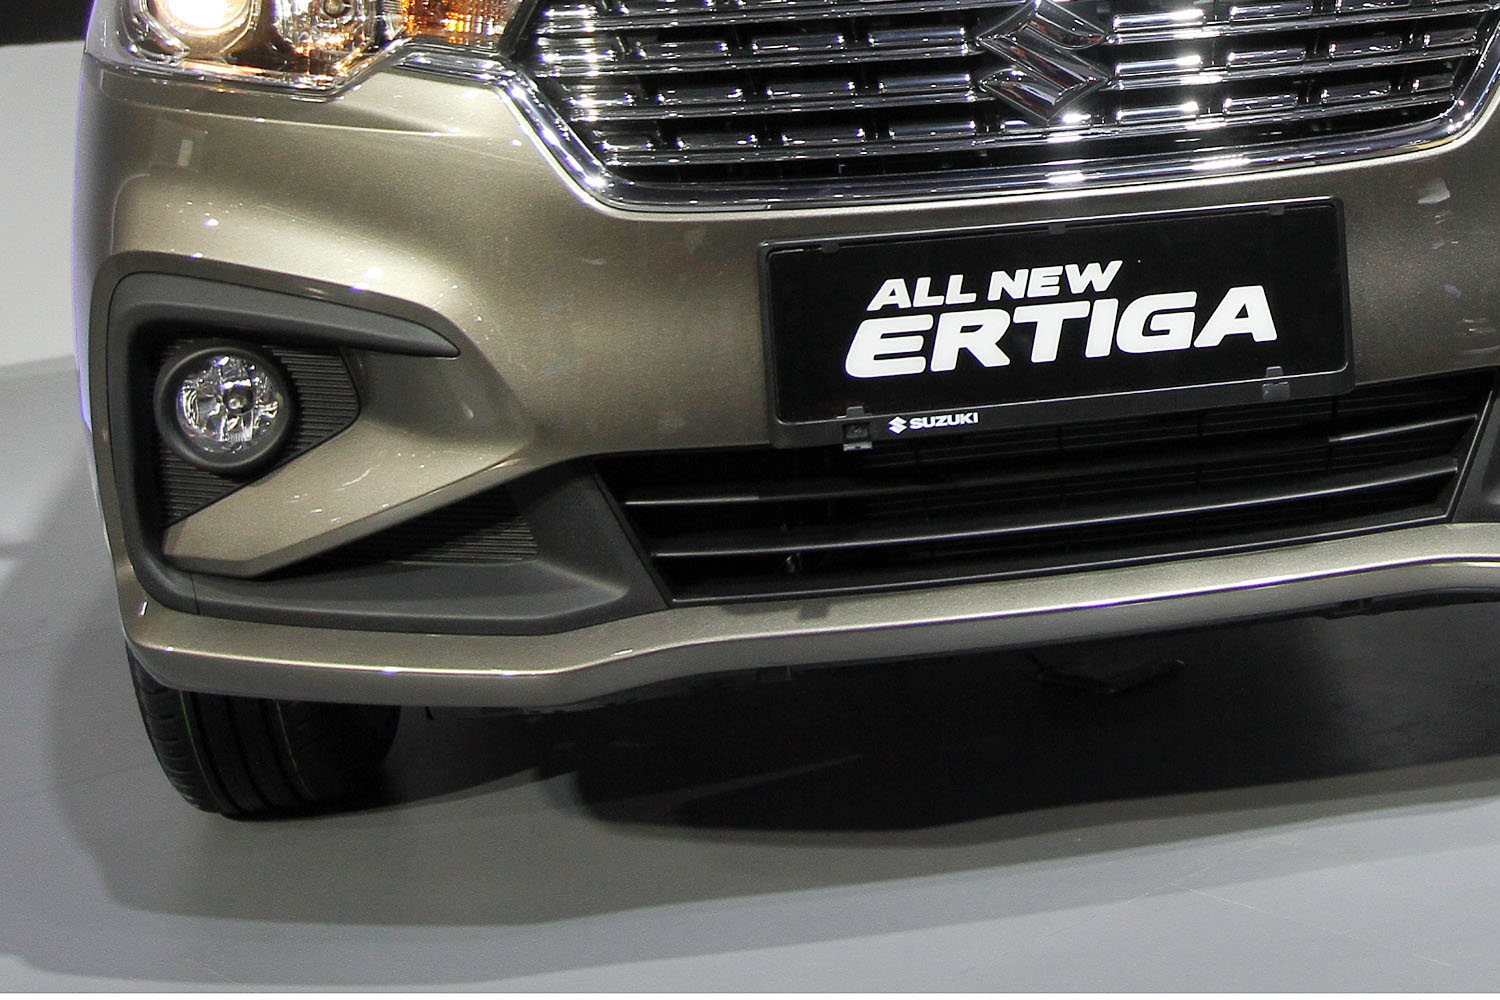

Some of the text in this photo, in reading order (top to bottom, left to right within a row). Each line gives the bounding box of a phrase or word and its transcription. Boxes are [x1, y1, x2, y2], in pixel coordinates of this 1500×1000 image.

[866, 260, 1123, 311] ALL NEW
[845, 285, 1278, 378] ERTIGA
[909, 412, 979, 430] SUZUKI
